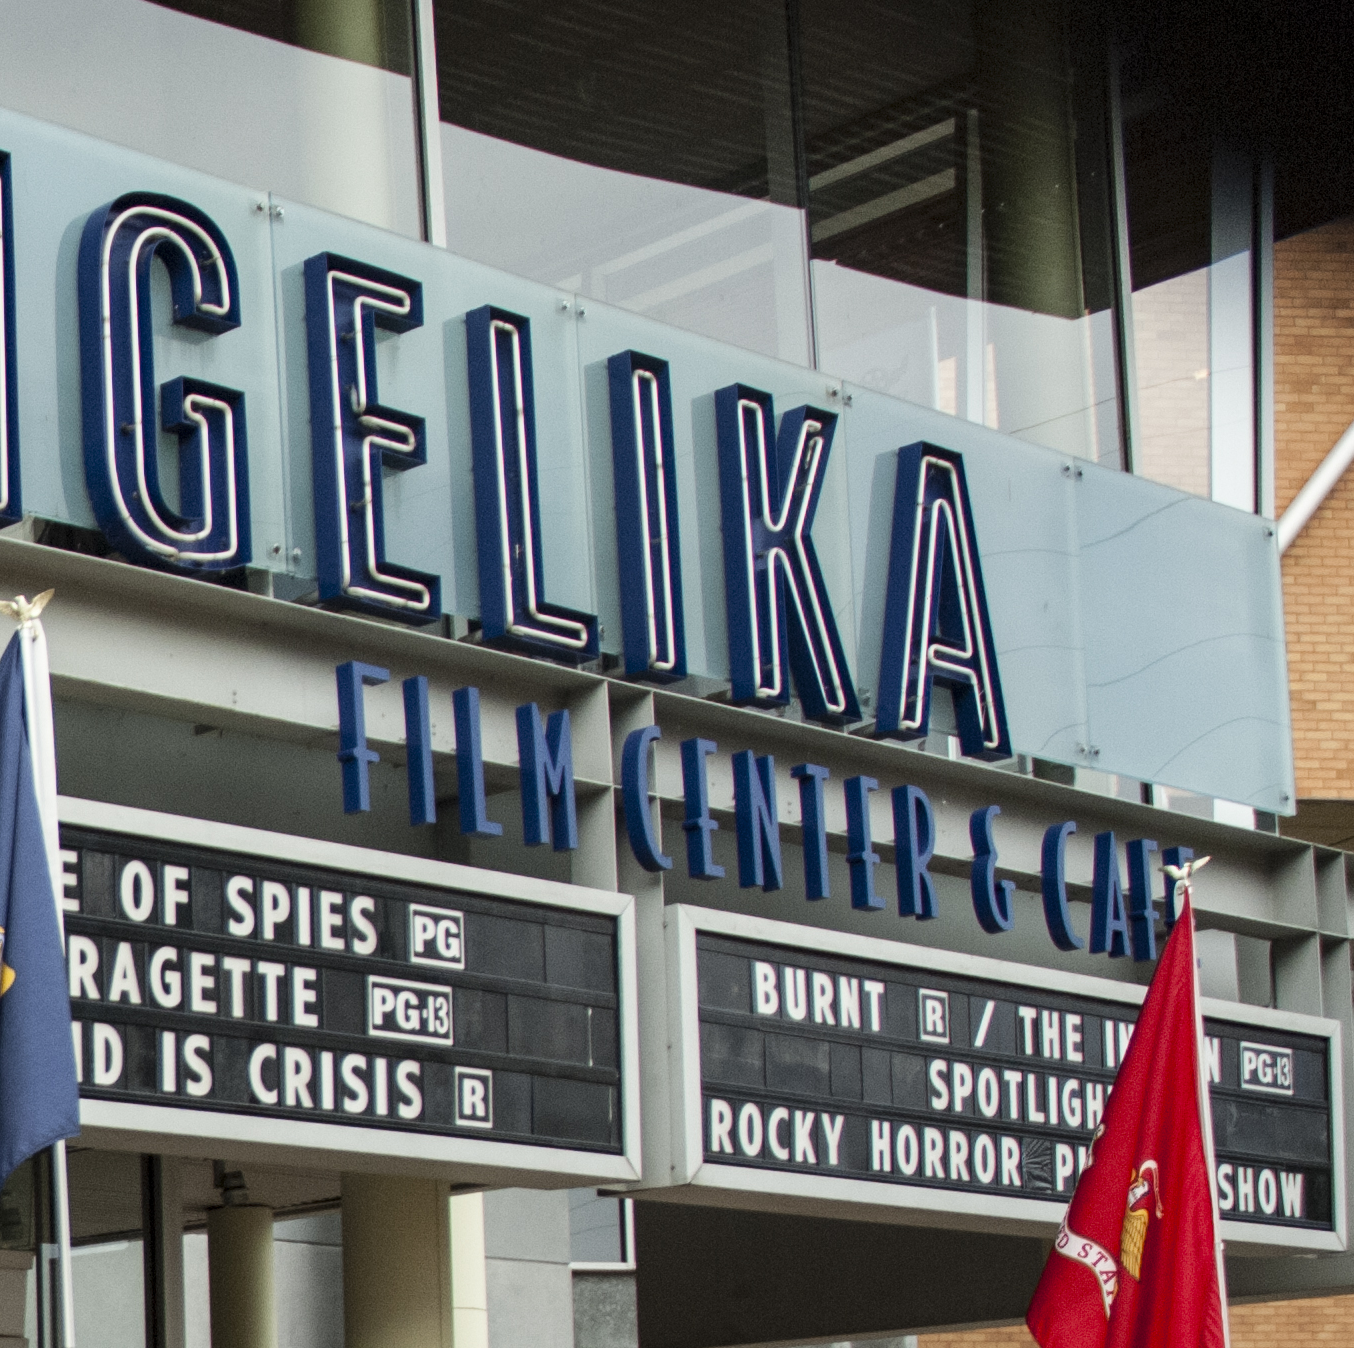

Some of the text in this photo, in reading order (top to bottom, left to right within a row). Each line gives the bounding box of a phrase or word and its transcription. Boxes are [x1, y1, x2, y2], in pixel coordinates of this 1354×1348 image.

[335, 660, 579, 850] FILM
[622, 725, 940, 921] CENTER
[970, 804, 1016, 934] &
[121, 861, 188, 924] OF
[227, 876, 376, 954] SPIES
[415, 914, 459, 960] PG
[755, 962, 884, 1031] BURNT
[1019, 1006, 1082, 1062] THE
[163, 1032, 211, 1096] IS
[250, 1044, 421, 1119] CRISIS
[463, 1079, 485, 1116] R
[930, 1060, 1113, 1129] SPOTLIGH
[711, 1099, 843, 1165] ROCKY
[872, 1120, 1021, 1186] HORROR
[1218, 1164, 1303, 1217] SHOW
